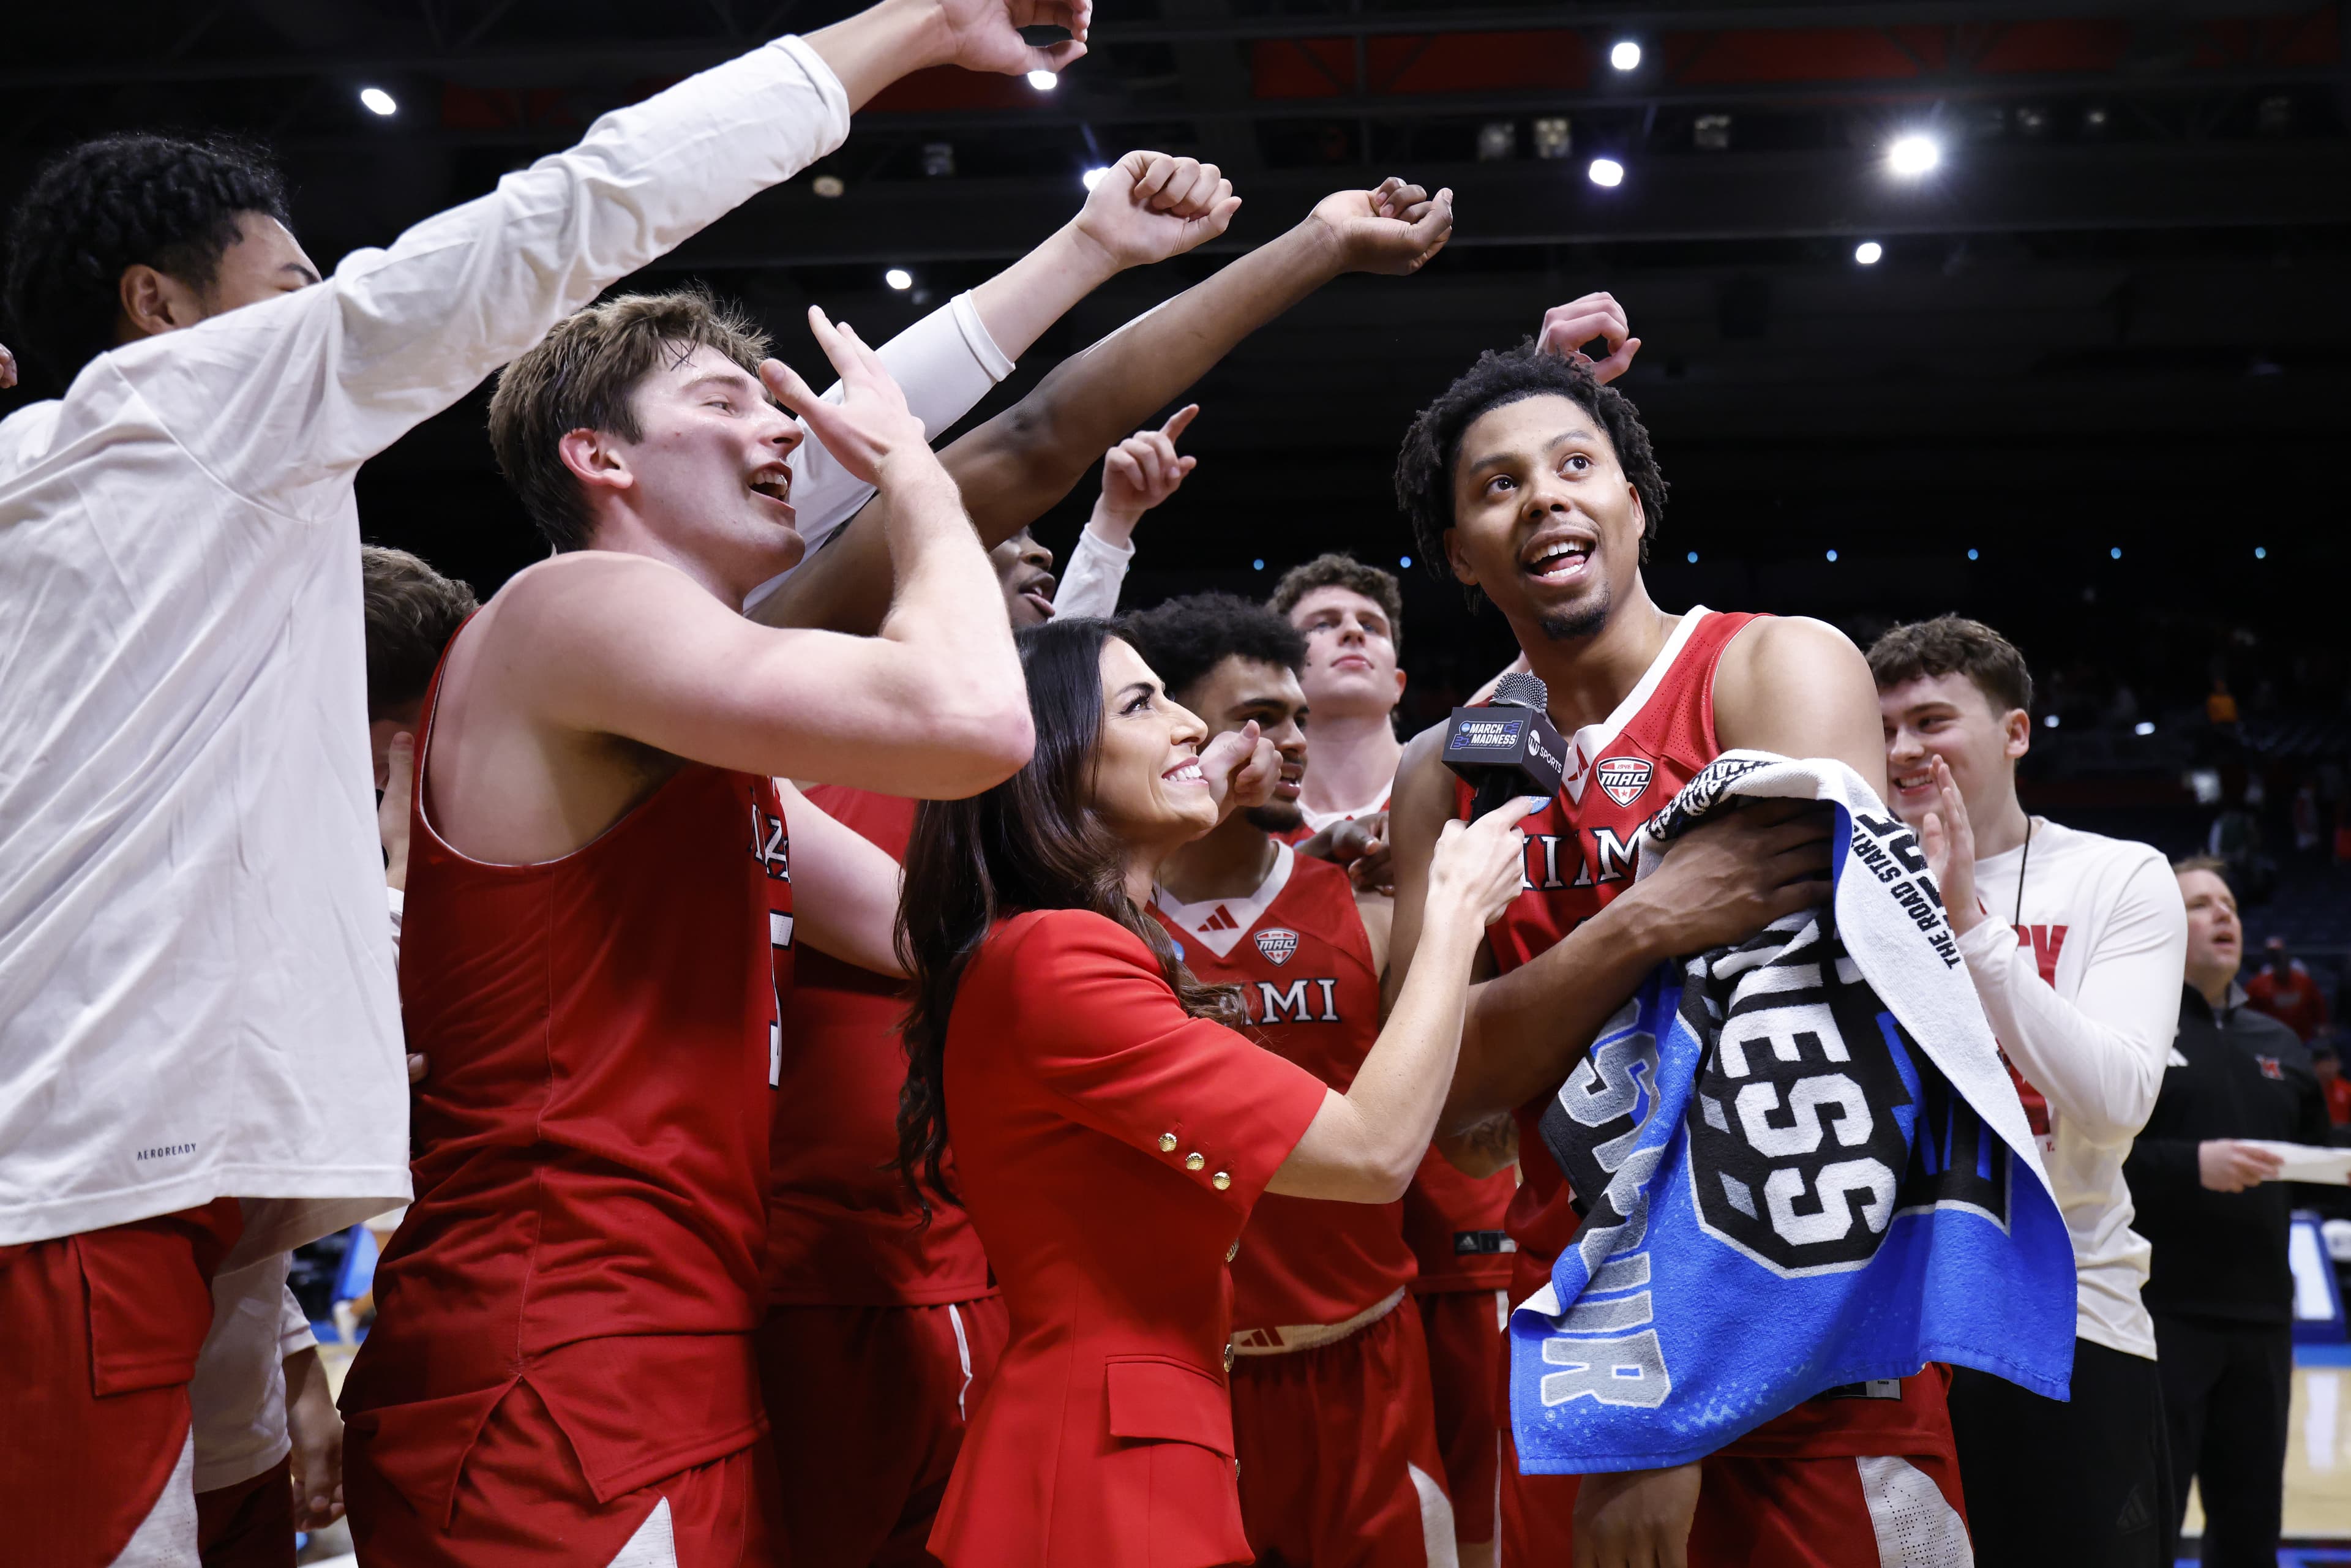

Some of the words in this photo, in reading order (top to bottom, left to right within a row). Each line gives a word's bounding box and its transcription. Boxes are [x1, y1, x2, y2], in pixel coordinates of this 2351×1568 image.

[1469, 724, 1504, 734] MARCH
[1471, 734, 1517, 745] MADNESS
[1539, 748, 1562, 774] SPORTS
[1600, 773, 1649, 786] MAC
[1851, 824, 1902, 883] START
[1890, 881, 1941, 932] ROAD
[1259, 939, 1297, 950] MAC
[1929, 930, 1960, 970] THE
[137, 1143, 197, 1161] AEROREADY
